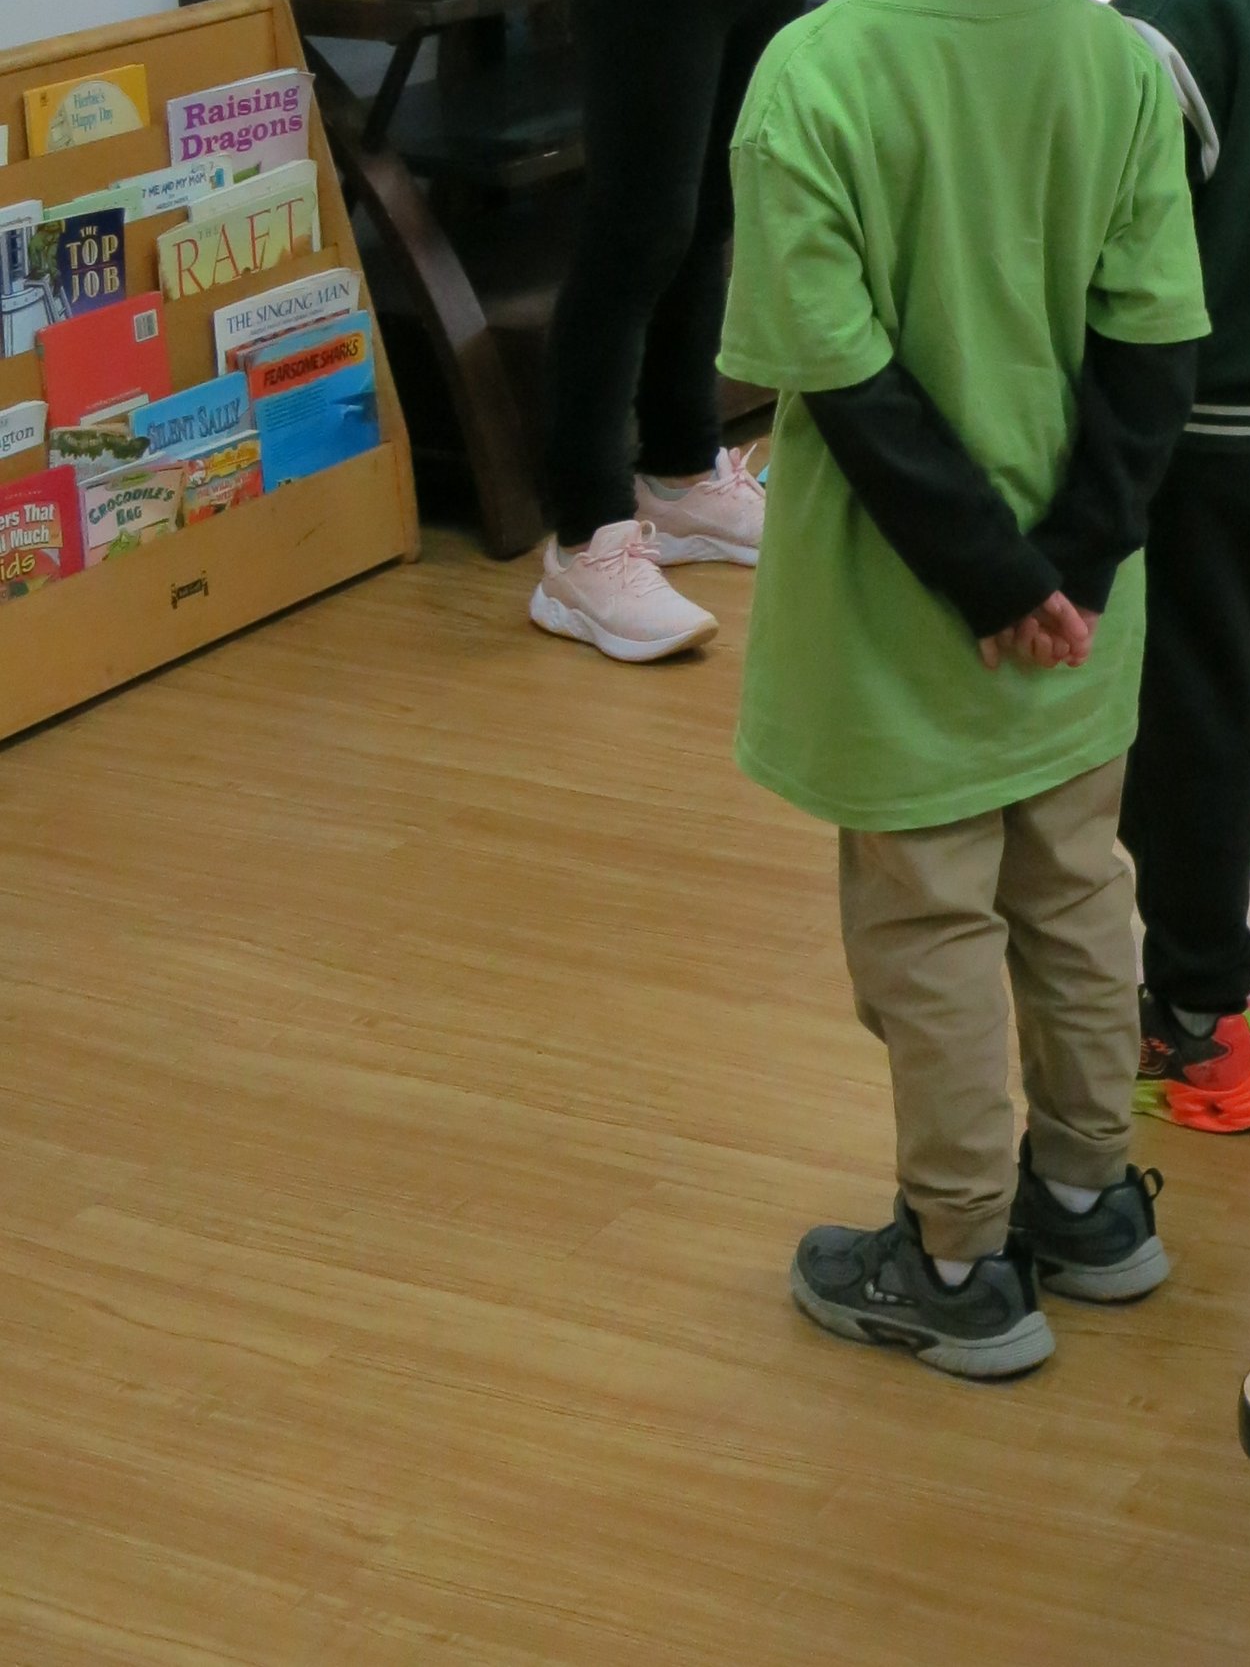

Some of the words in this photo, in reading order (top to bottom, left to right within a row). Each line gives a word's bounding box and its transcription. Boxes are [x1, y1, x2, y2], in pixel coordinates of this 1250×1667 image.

[183, 85, 301, 130] Raising
[180, 113, 303, 161] Dragons
[80, 225, 98, 236] THE
[172, 197, 304, 297] RAFT
[65, 234, 119, 269] TOP
[71, 266, 120, 303] JOB
[226, 311, 252, 334] THE
[256, 293, 313, 322] SINGING
[317, 281, 350, 304] MAN
[264, 353, 320, 387] FEARSOME
[319, 338, 359, 368] SHARKS
[0, 426, 34, 451] gton
[147, 415, 195, 455] SILENT
[198, 398, 241, 438] SALLY
[24, 503, 56, 523] That
[89, 487, 175, 524] CROCODILE'S
[116, 505, 142, 527] BAG
[10, 525, 49, 549] Much
